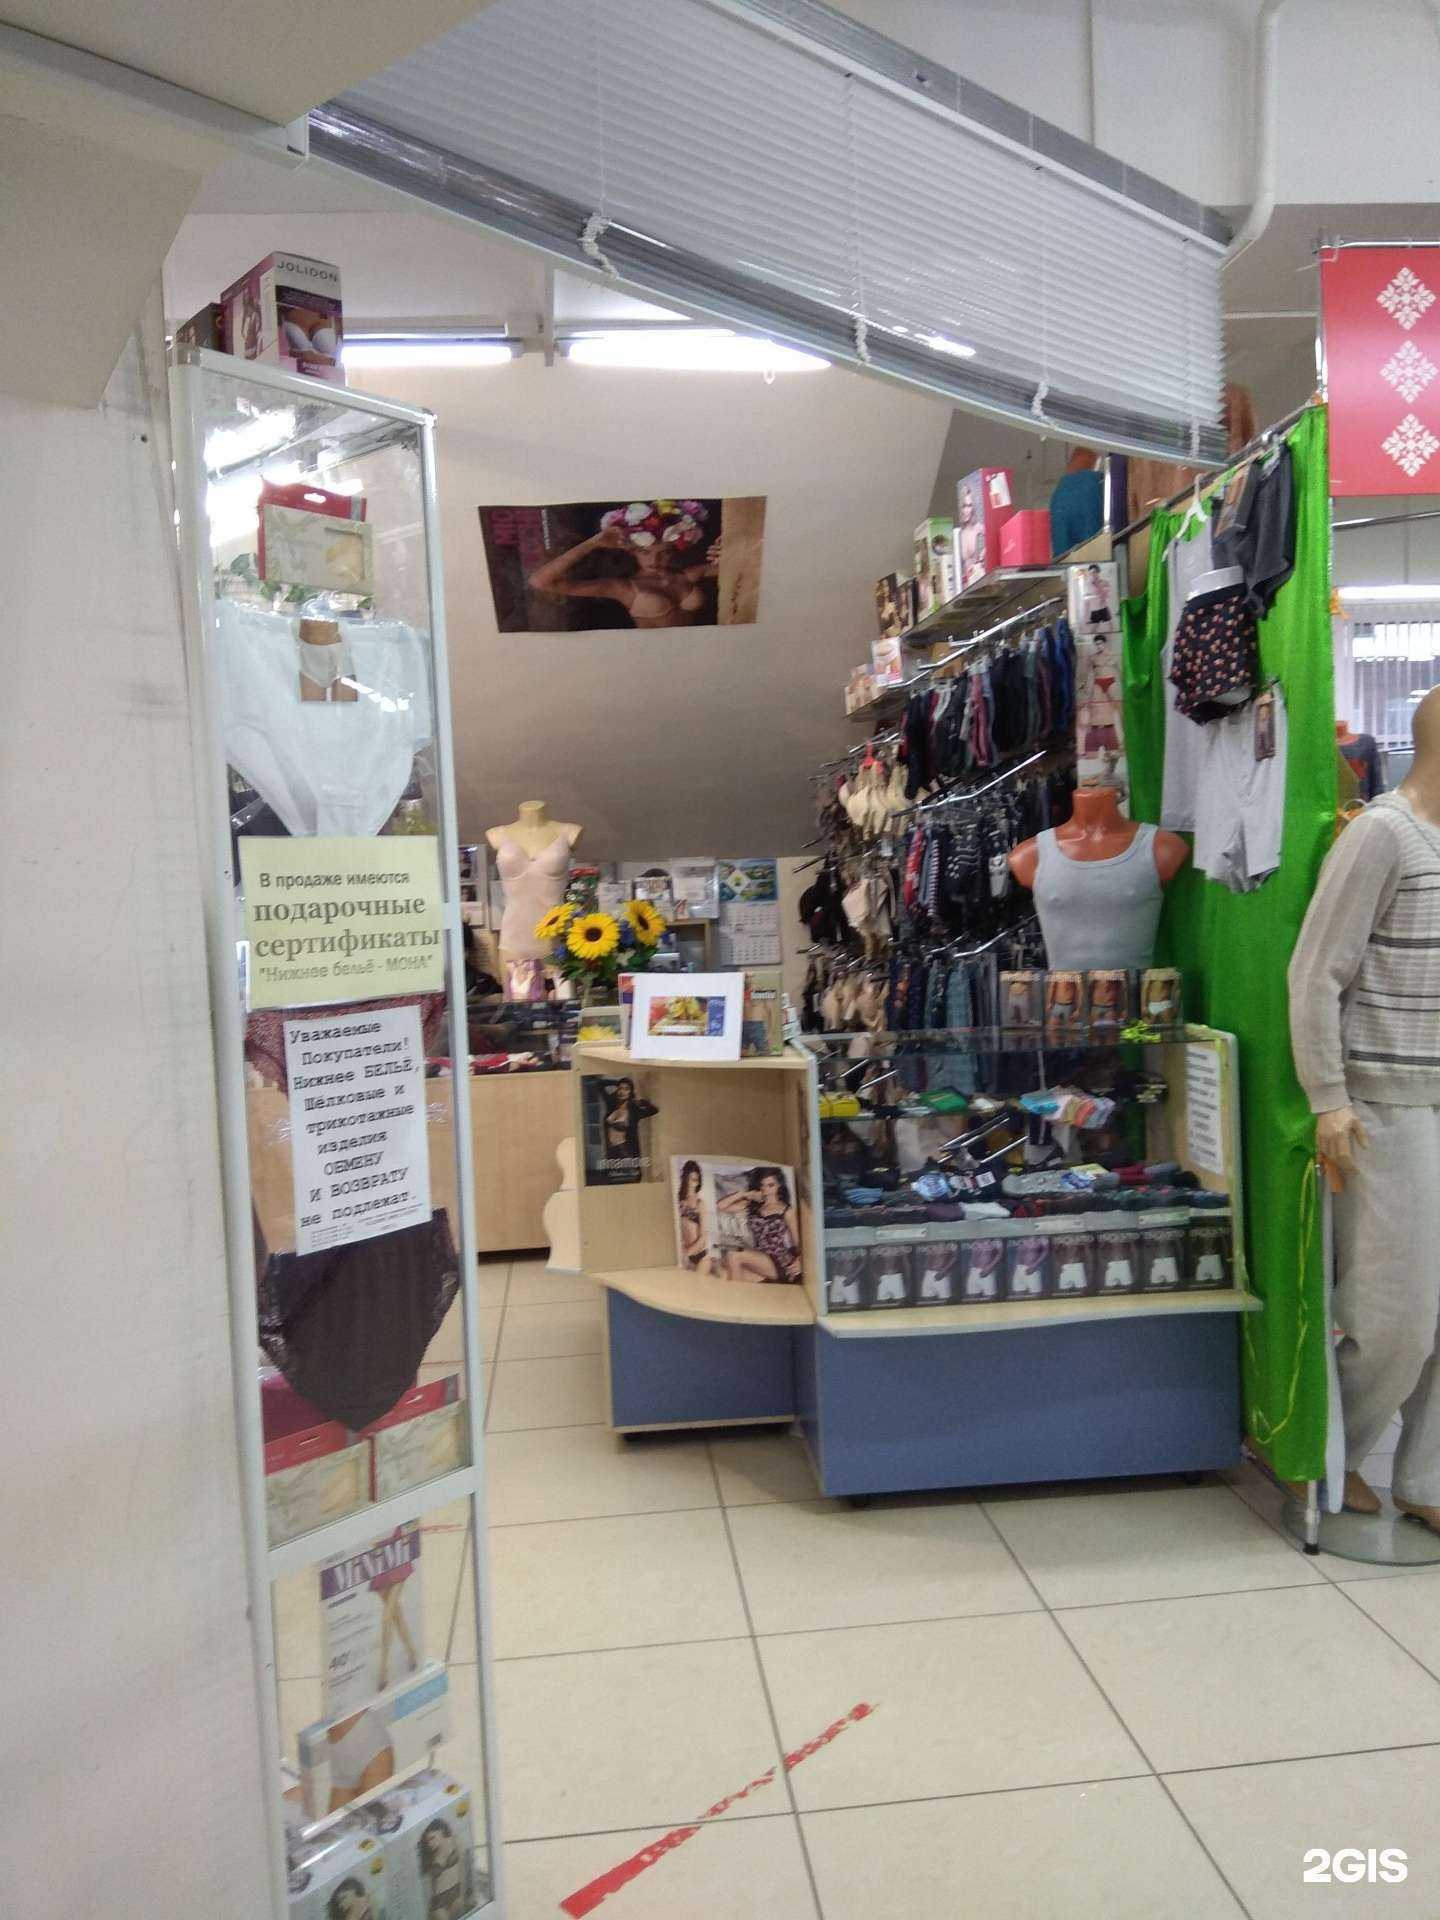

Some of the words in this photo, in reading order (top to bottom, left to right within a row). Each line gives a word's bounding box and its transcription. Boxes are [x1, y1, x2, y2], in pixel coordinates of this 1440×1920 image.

[277, 260, 339, 282] JOLIDON
[260, 873, 271, 887] В
[276, 875, 342, 889] продаже
[347, 872, 410, 884] имеются
[253, 898, 426, 924] подарочные
[255, 929, 440, 961] сертификаты
[289, 1021, 382, 1044] Уважаемые
[302, 1037, 410, 1065] Покупатели!
[293, 1071, 355, 1090] Нижнее
[395, 1084, 405, 1095] и
[306, 1104, 415, 1136] трикотажные
[317, 1131, 388, 1154] изделия
[323, 1151, 384, 1176] ОБМЕНУ
[310, 1188, 321, 1203] И
[331, 1167, 409, 1198] ВОЗВРАТУ
[300, 1214, 321, 1228] не
